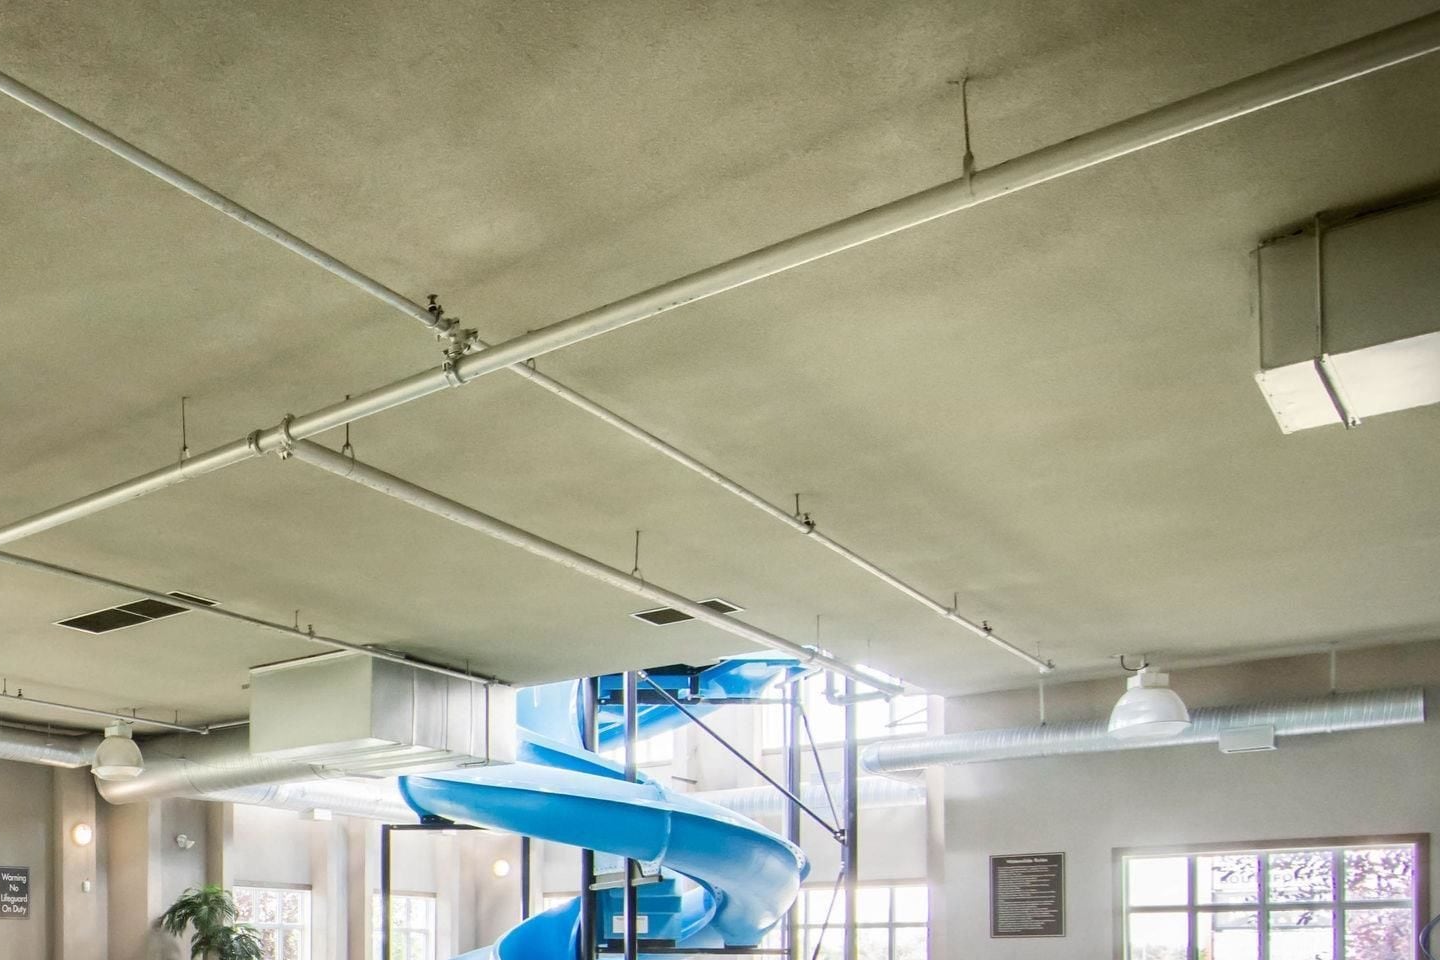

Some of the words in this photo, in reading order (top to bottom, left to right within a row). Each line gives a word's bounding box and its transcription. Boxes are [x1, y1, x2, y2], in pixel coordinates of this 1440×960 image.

[1, 873, 27, 884] Warning
[9, 883, 19, 892] No
[1, 893, 27, 904] Lifeguard
[1, 904, 12, 913] On
[12, 904, 27, 916] Duty
